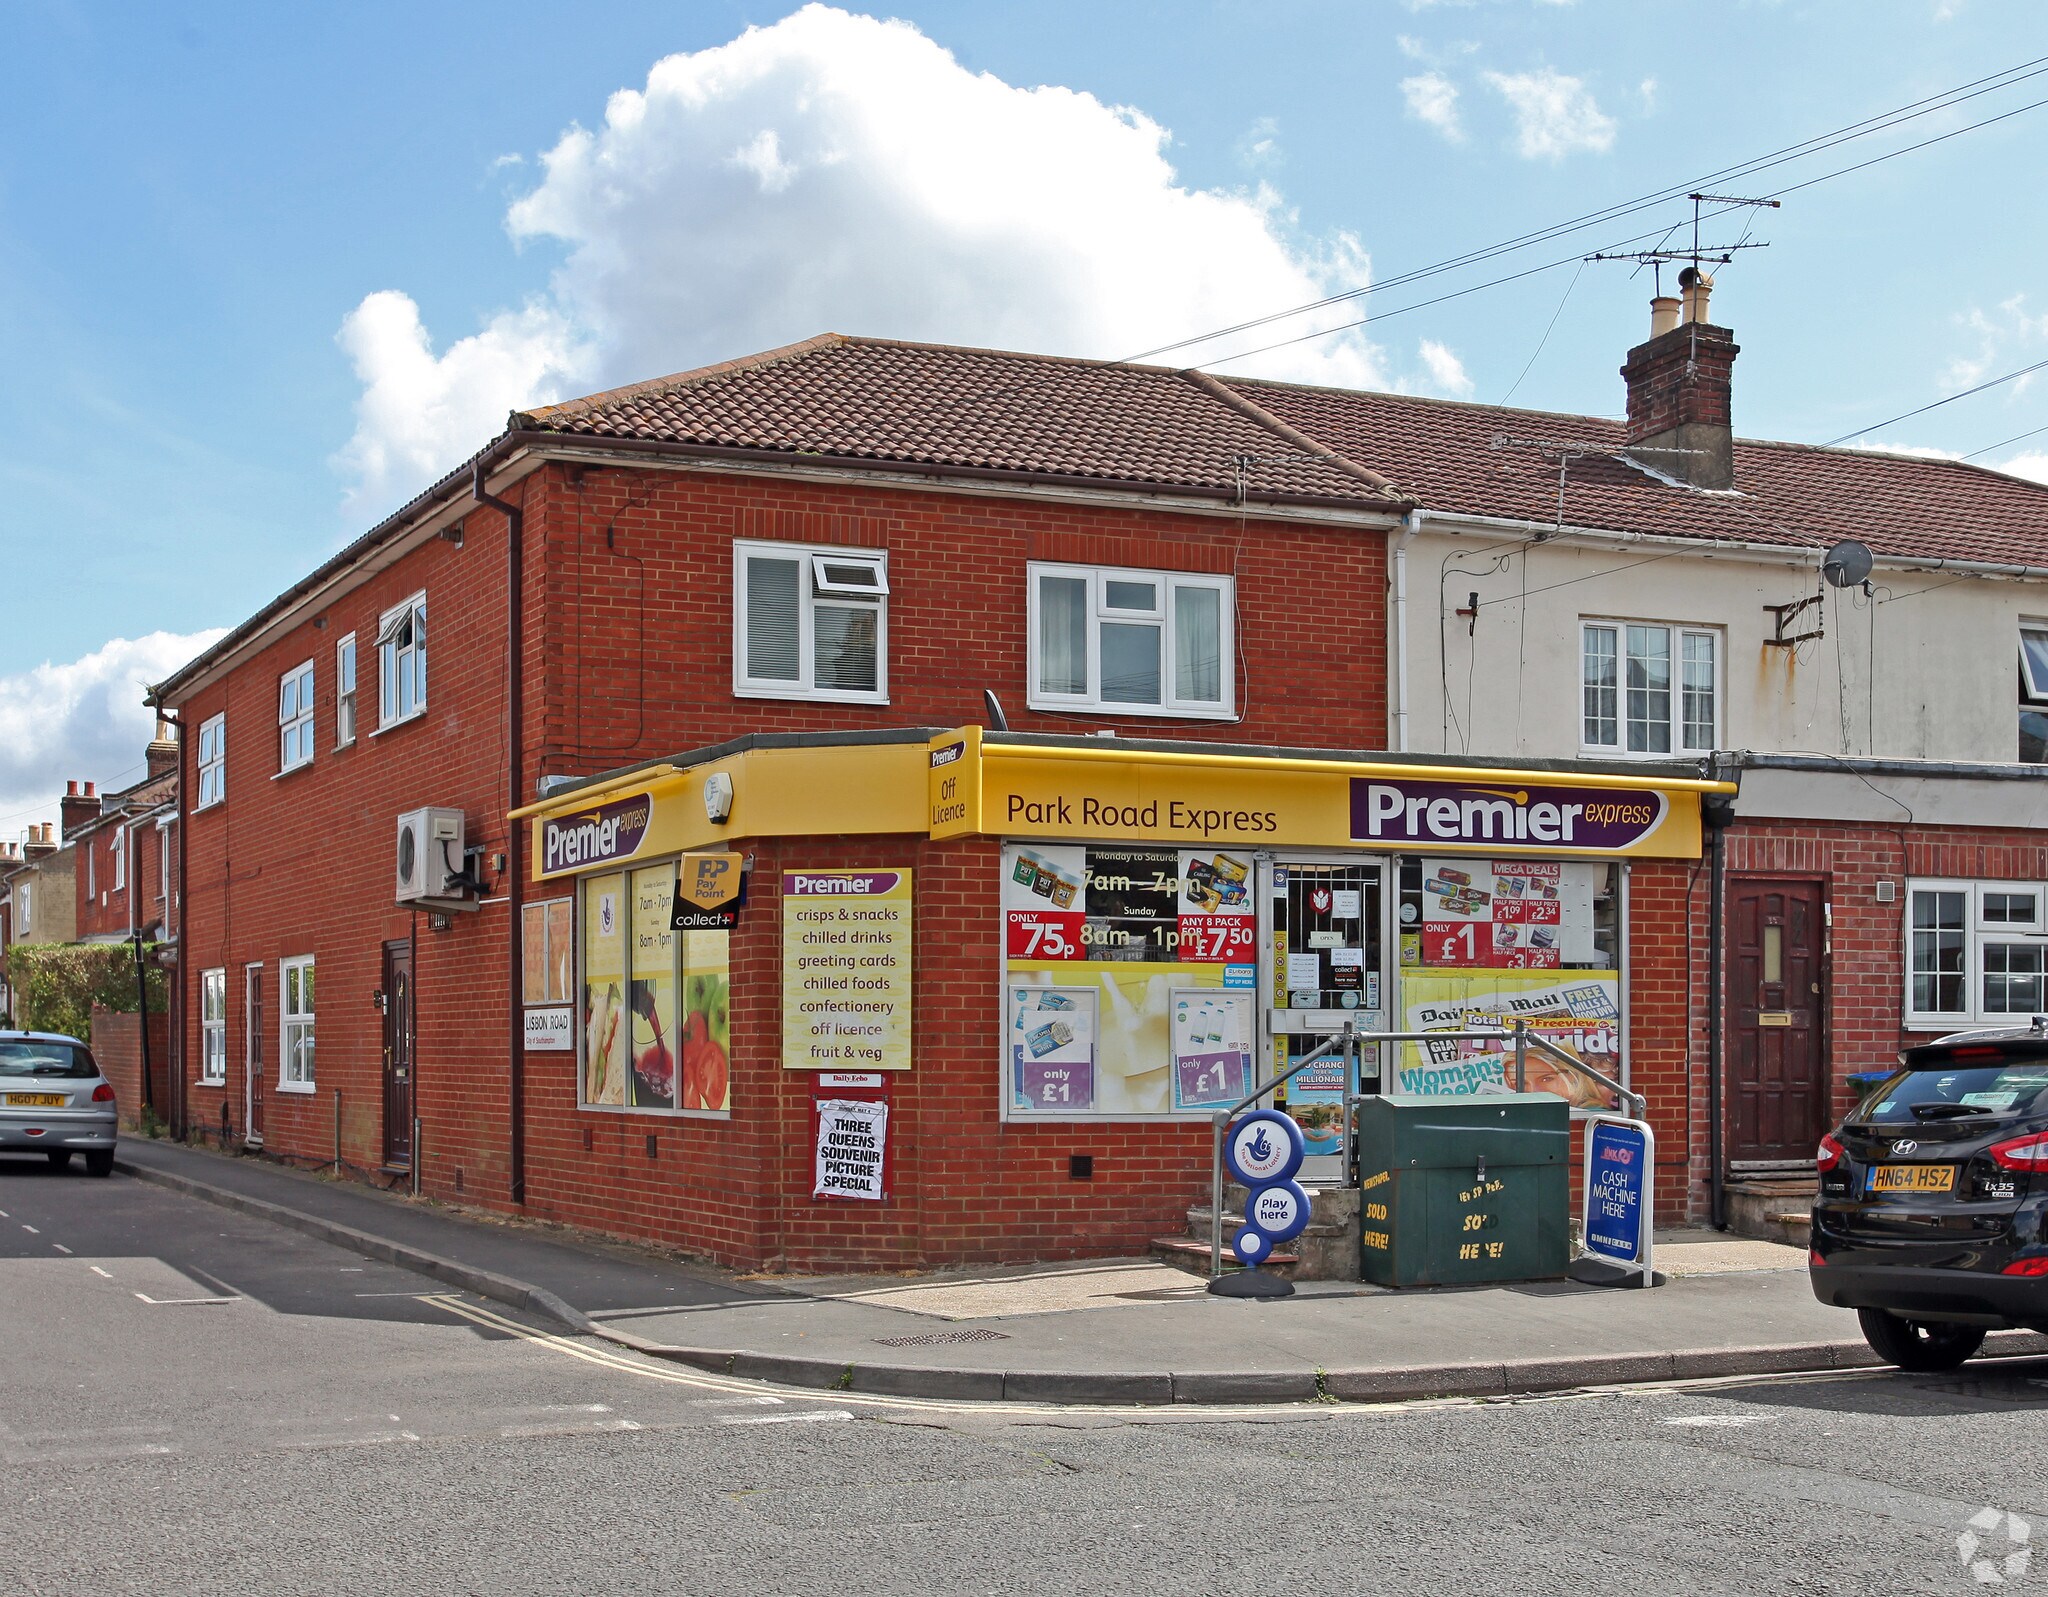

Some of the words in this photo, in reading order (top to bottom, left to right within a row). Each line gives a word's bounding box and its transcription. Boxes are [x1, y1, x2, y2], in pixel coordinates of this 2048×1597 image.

[932, 747, 957, 767] Premier
[941, 776, 956, 801] Off
[932, 803, 965, 825] Licence
[1007, 794, 1073, 825] Park
[1082, 797, 1158, 828] Road
[1169, 800, 1278, 837] Express
[1368, 784, 1583, 842] Premier
[1584, 803, 1651, 828] express
[547, 812, 621, 869] Premier
[620, 808, 646, 835] express
[1095, 851, 1133, 862] Monday
[1134, 852, 1143, 861] to
[1145, 852, 1184, 863] Saturday
[1494, 863, 1525, 874] MEGA
[1526, 864, 1559, 876] DEALS
[697, 879, 716, 890] Pay
[794, 874, 873, 894] Premier
[1080, 869, 1130, 891] 7am
[1151, 871, 1201, 898] 7pm
[695, 889, 725, 898] Point
[640, 896, 653, 911] 7am
[658, 894, 672, 912] 7pm
[1124, 906, 1157, 917] Sunday
[796, 908, 834, 924] crisps
[838, 908, 849, 921] &
[853, 907, 899, 921] snacks
[1009, 913, 1038, 922] ONLY
[1497, 905, 1521, 919] £1.09
[1531, 906, 1556, 920] £2.34
[1181, 917, 1203, 926] ANY
[1206, 917, 1213, 926] 8
[1215, 917, 1242, 926] PACK
[1425, 923, 1451, 932] ONLY
[802, 931, 846, 944] chilled
[850, 931, 892, 944] drinks
[1079, 923, 1130, 946] 8am
[1152, 925, 1200, 952] 1pm
[1502, 926, 1515, 937] Sun
[640, 933, 653, 948] 8am
[658, 932, 672, 949] 1pm
[1021, 923, 1075, 959] 75p
[1195, 927, 1253, 957] £7.50
[1441, 923, 1475, 960] £1
[798, 954, 856, 970] greeting
[859, 953, 896, 967] cards
[1531, 954, 1555, 967] £2.19
[803, 977, 848, 990] chilled
[852, 976, 890, 990] foods
[1565, 986, 1604, 1003] FREE
[799, 999, 894, 1016] confectionery
[1419, 1006, 1481, 1024] Dai
[1508, 994, 1561, 1012] Mail
[1570, 998, 1601, 1013] MILLS
[1600, 996, 1609, 1006] &
[1597, 1004, 1615, 1018] DVD
[526, 1015, 548, 1031] LISBON
[550, 1014, 568, 1030] ROAD
[1465, 1013, 1503, 1026] Total
[1535, 1018, 1598, 1028] Freeview
[811, 1021, 832, 1035] off
[835, 1022, 883, 1036] licence
[810, 1045, 840, 1058] fruit
[844, 1045, 855, 1058] &
[858, 1048, 882, 1062] veg
[1430, 1040, 1459, 1053] GIA
[1182, 1058, 1201, 1070] only
[1313, 1061, 1345, 1069] CHANC
[1434, 1051, 1458, 1064] LEA
[833, 1074, 850, 1083] Daily
[852, 1074, 868, 1082] Echo
[1043, 1068, 1070, 1081] only
[1196, 1060, 1227, 1093] £1
[1295, 1075, 1345, 1084] MILLIONAIR
[1400, 1058, 1504, 1092] Woman's
[10, 1095, 38, 1106] HG07
[41, 1095, 61, 1105] JUY
[1042, 1083, 1070, 1102] £1
[834, 1118, 872, 1134] THREE
[828, 1132, 875, 1148] QUEENS
[821, 1146, 880, 1163] SOUVENIR
[1244, 1158, 1268, 1171] National
[1268, 1146, 1282, 1168] Lottery
[825, 1161, 874, 1177] PICTURE
[1875, 1168, 1914, 1187] HN64
[1917, 1168, 1951, 1187] HSZ
[823, 1175, 872, 1191] SPECIAL
[1601, 1170, 1628, 1188] CASH
[1592, 1183, 1637, 1206] MACHINE
[1261, 1199, 1288, 1210] Play
[1366, 1202, 1387, 1220] SOLD
[1601, 1201, 1626, 1219] HERE
[1260, 1210, 1288, 1219] here
[1364, 1230, 1389, 1250] HERE!
[1459, 1242, 1504, 1260] HEE!
